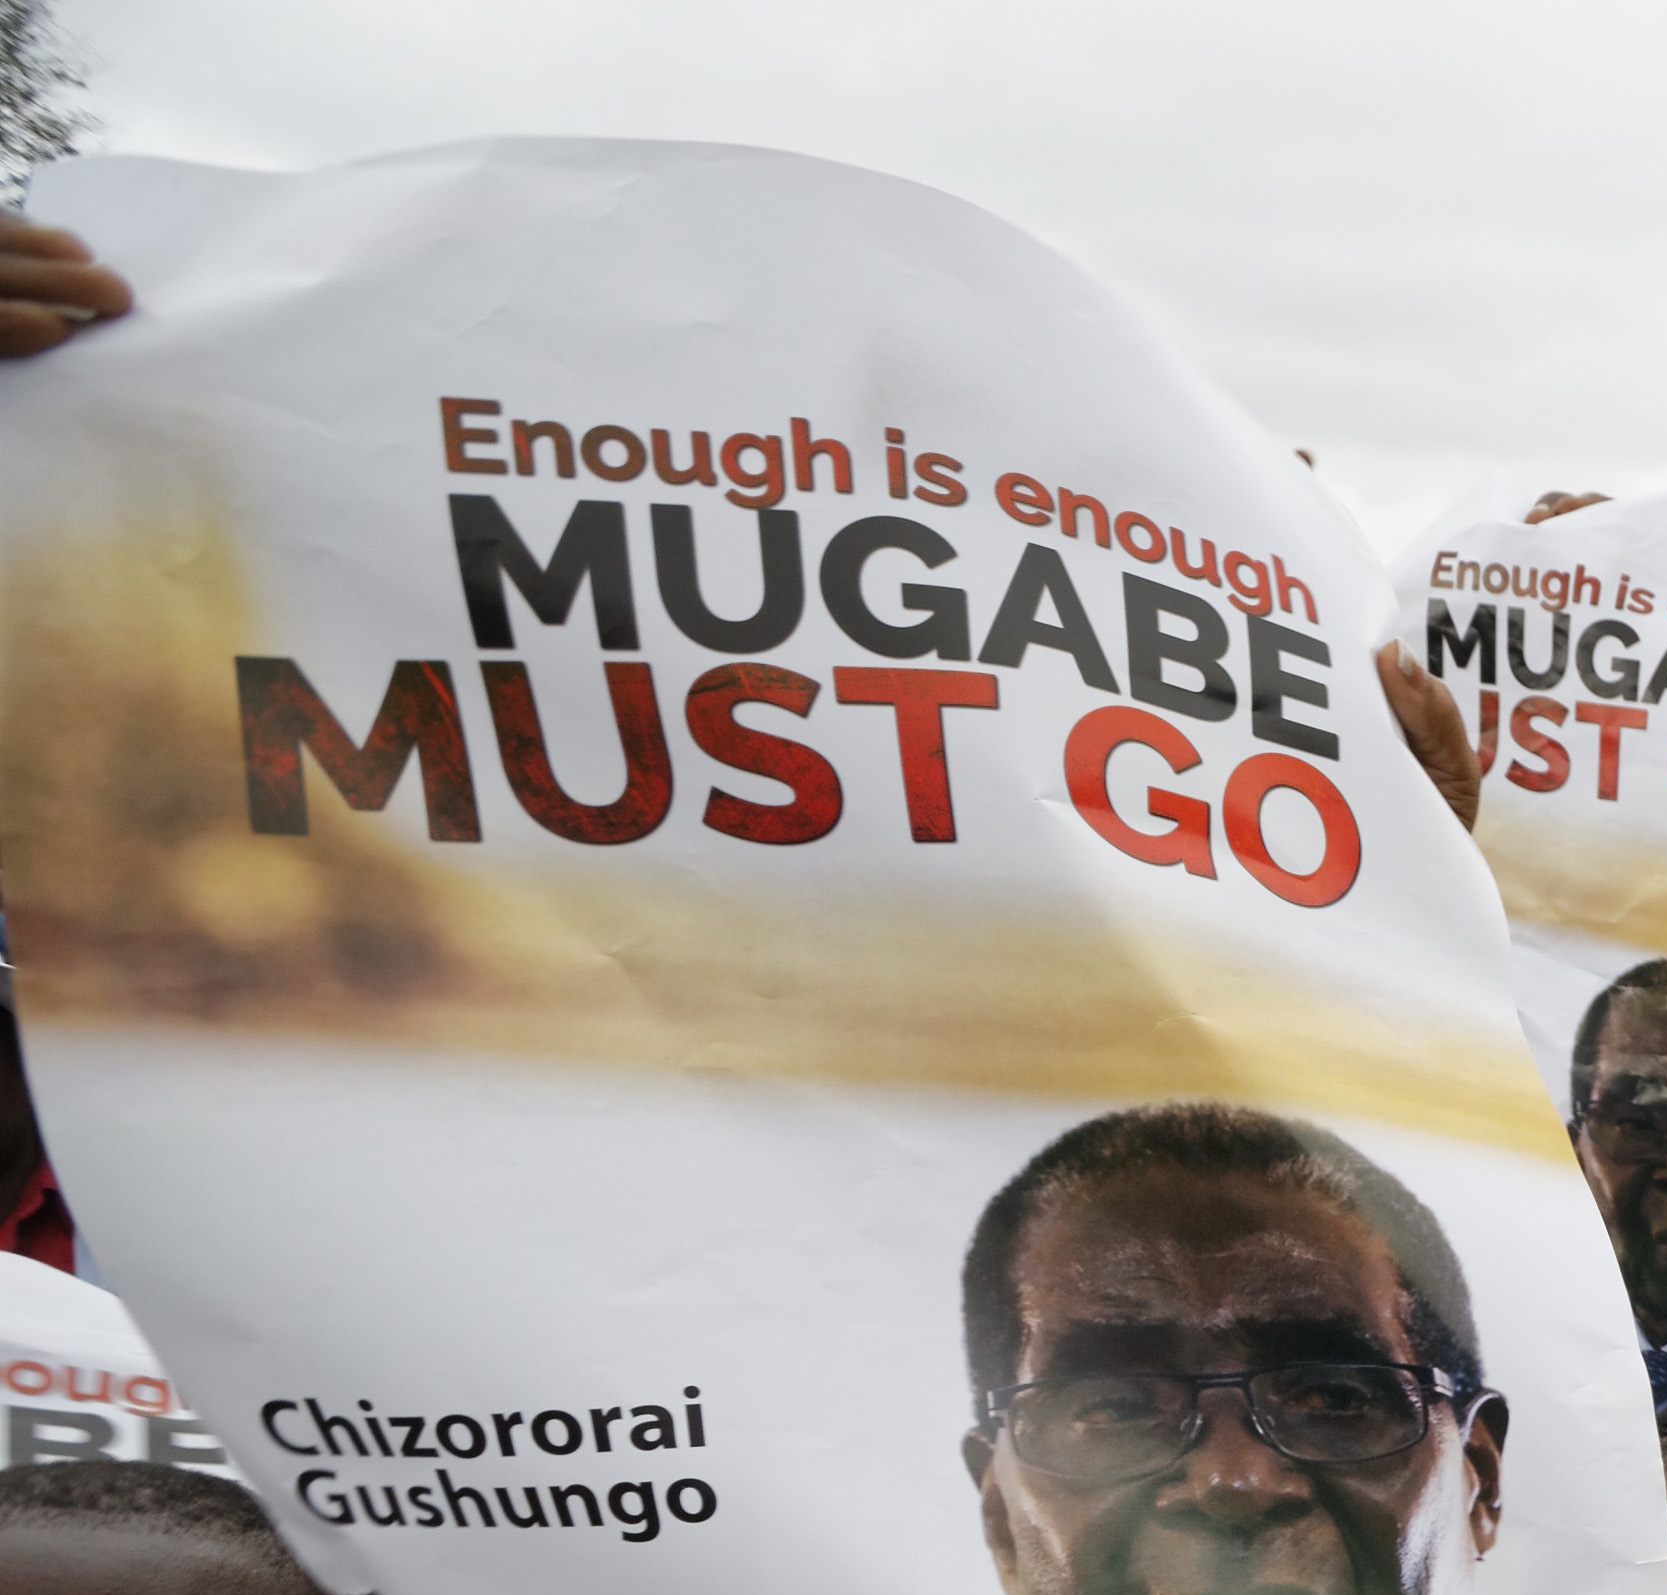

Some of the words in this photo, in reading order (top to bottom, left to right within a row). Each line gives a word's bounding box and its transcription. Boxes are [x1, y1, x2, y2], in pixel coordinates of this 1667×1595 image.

[440, 397, 853, 507] Enough
[884, 427, 967, 506] is
[995, 469, 1320, 624] enough
[1430, 551, 1602, 612] Enough
[1615, 574, 1656, 616] is
[447, 492, 1341, 761] MUGABE
[235, 655, 999, 846] MUST
[1063, 704, 1363, 909] GO
[260, 1384, 707, 1460] Chizororai
[296, 1469, 718, 1543] Gushungo
